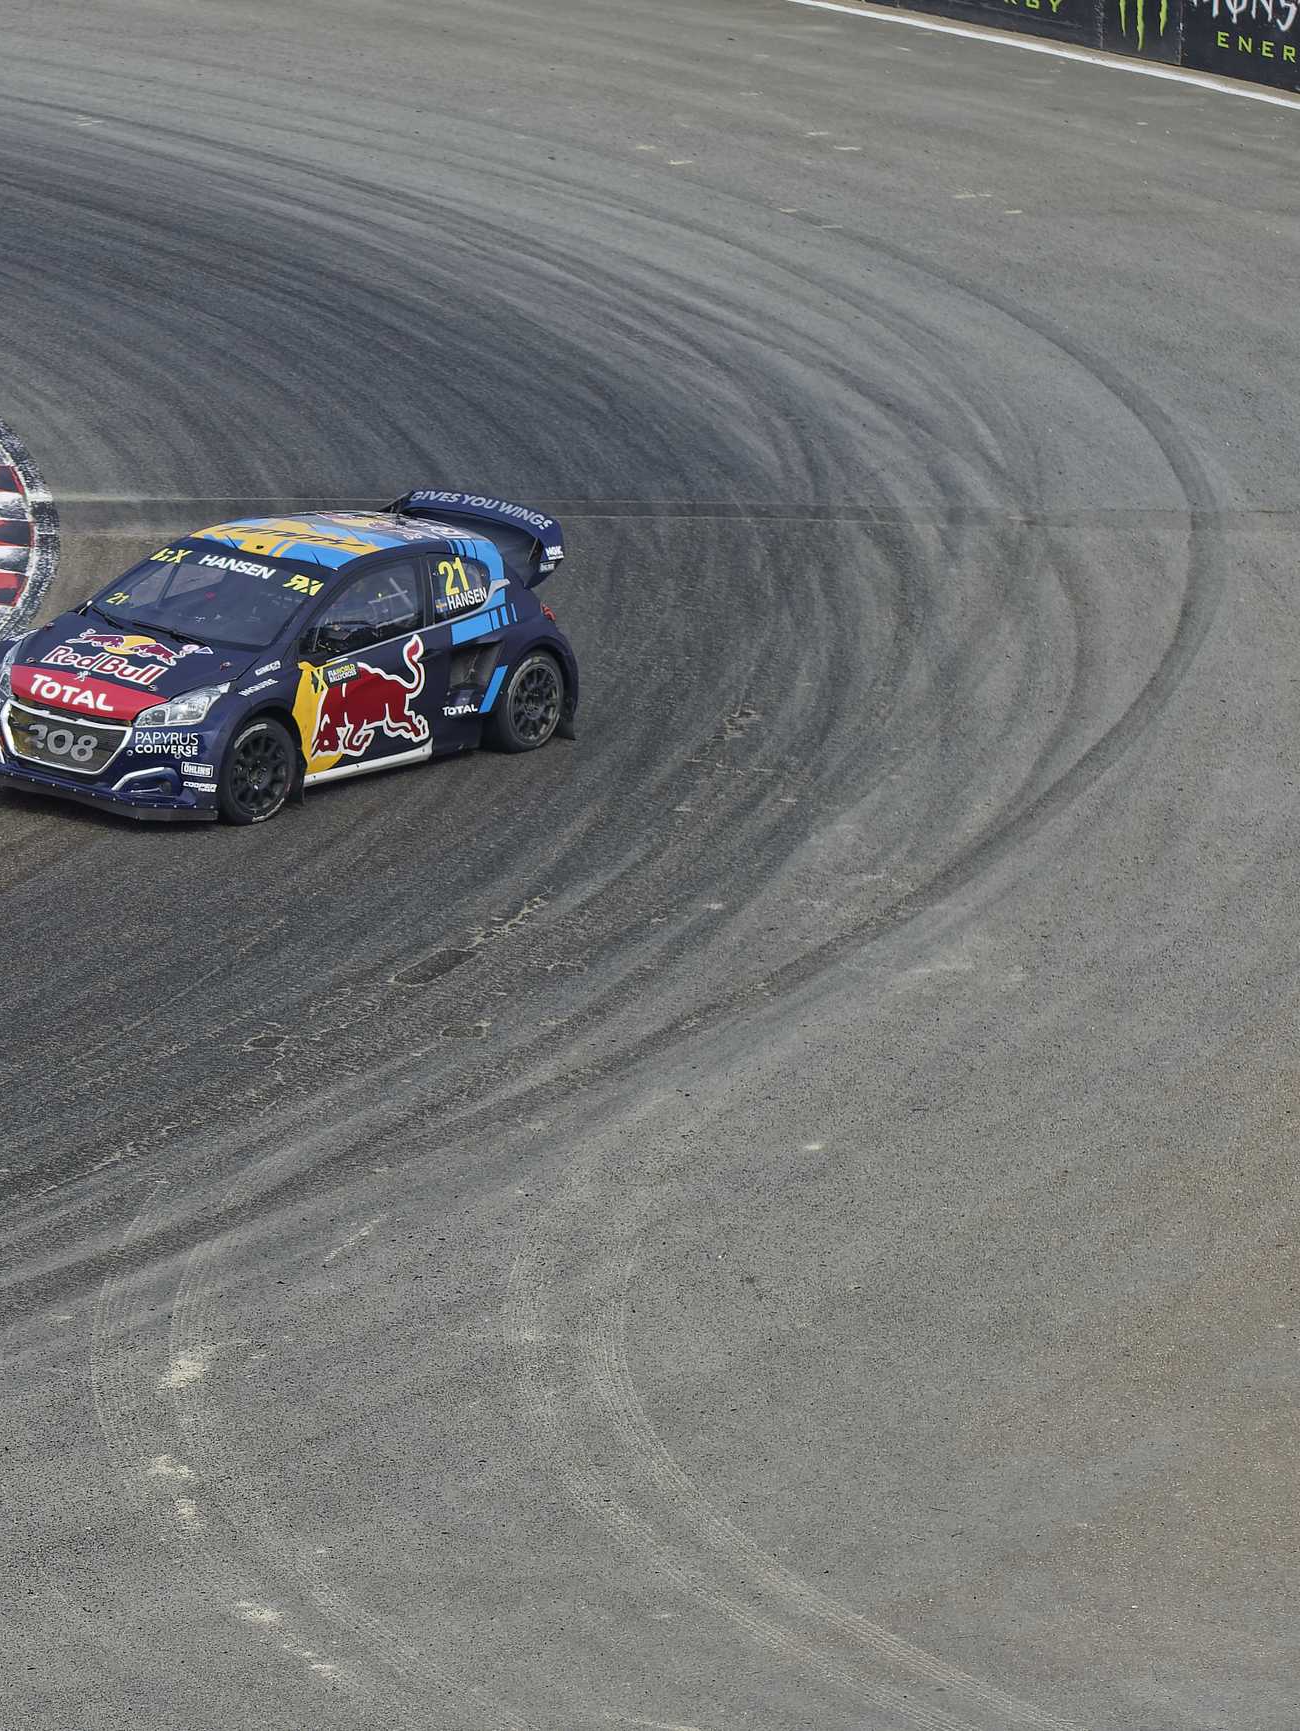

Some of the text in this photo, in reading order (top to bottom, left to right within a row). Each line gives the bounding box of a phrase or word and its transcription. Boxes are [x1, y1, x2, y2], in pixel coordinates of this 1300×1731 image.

[410, 490, 553, 531] GIVES YOU WINGS
[198, 554, 276, 580] HANSEN
[438, 556, 470, 596] 21
[446, 586, 488, 611] HANSEN
[41, 645, 169, 686] Red Bull
[30, 673, 114, 713] TOTAL
[441, 703, 479, 717] TOTAL
[134, 731, 199, 746] PAPYRUS
